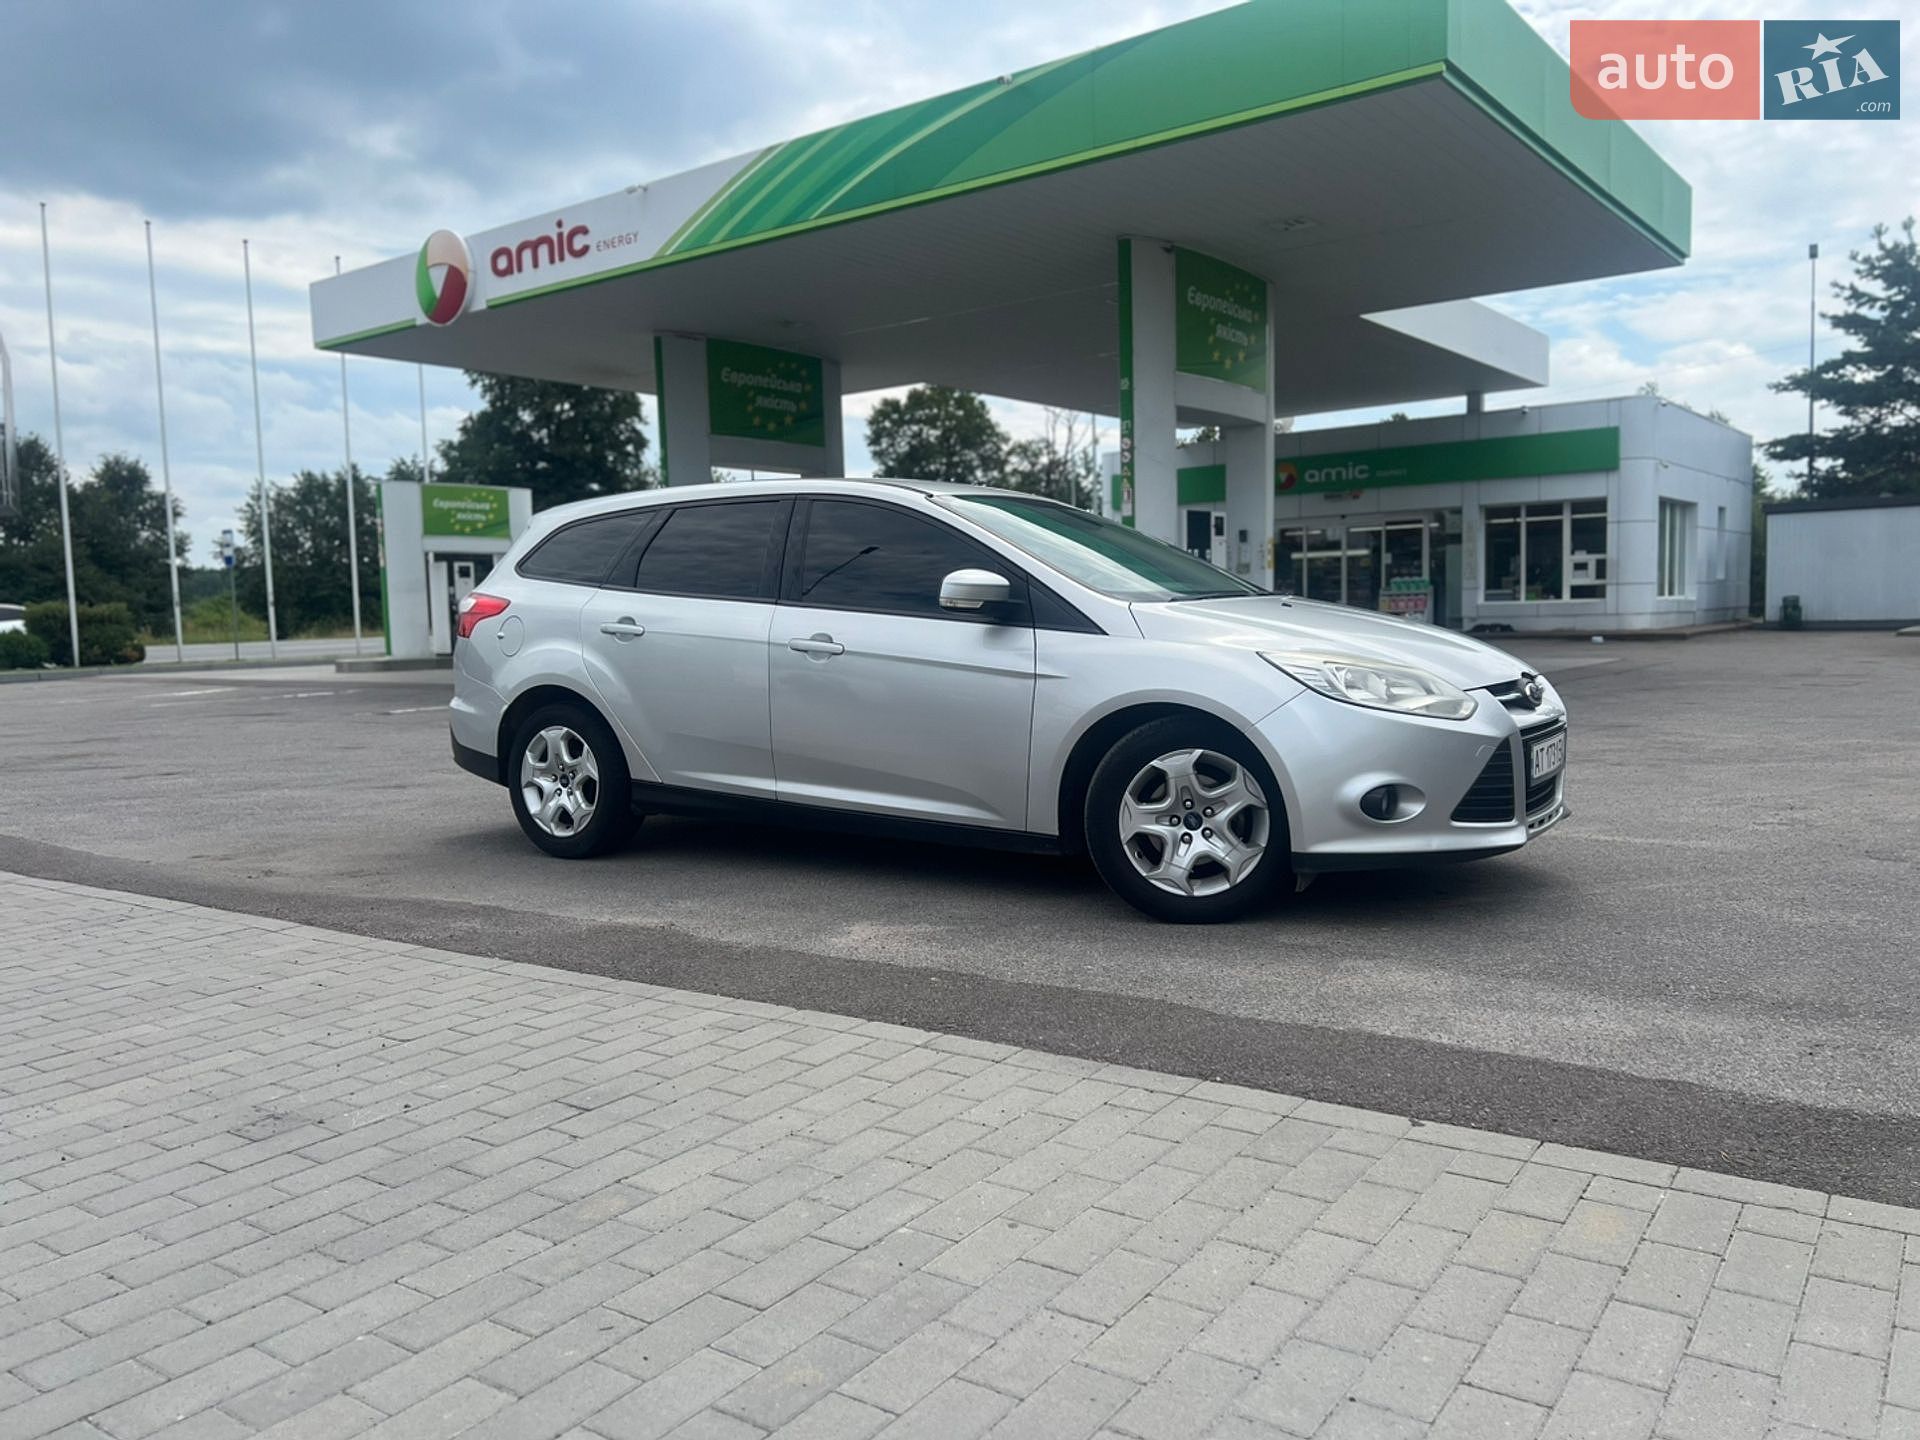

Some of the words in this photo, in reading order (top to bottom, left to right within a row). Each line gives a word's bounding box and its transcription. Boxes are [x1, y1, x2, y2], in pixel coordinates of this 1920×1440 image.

[490, 218, 590, 278] amic
[596, 231, 639, 252] ENERGY
[1304, 461, 1369, 484] amic
